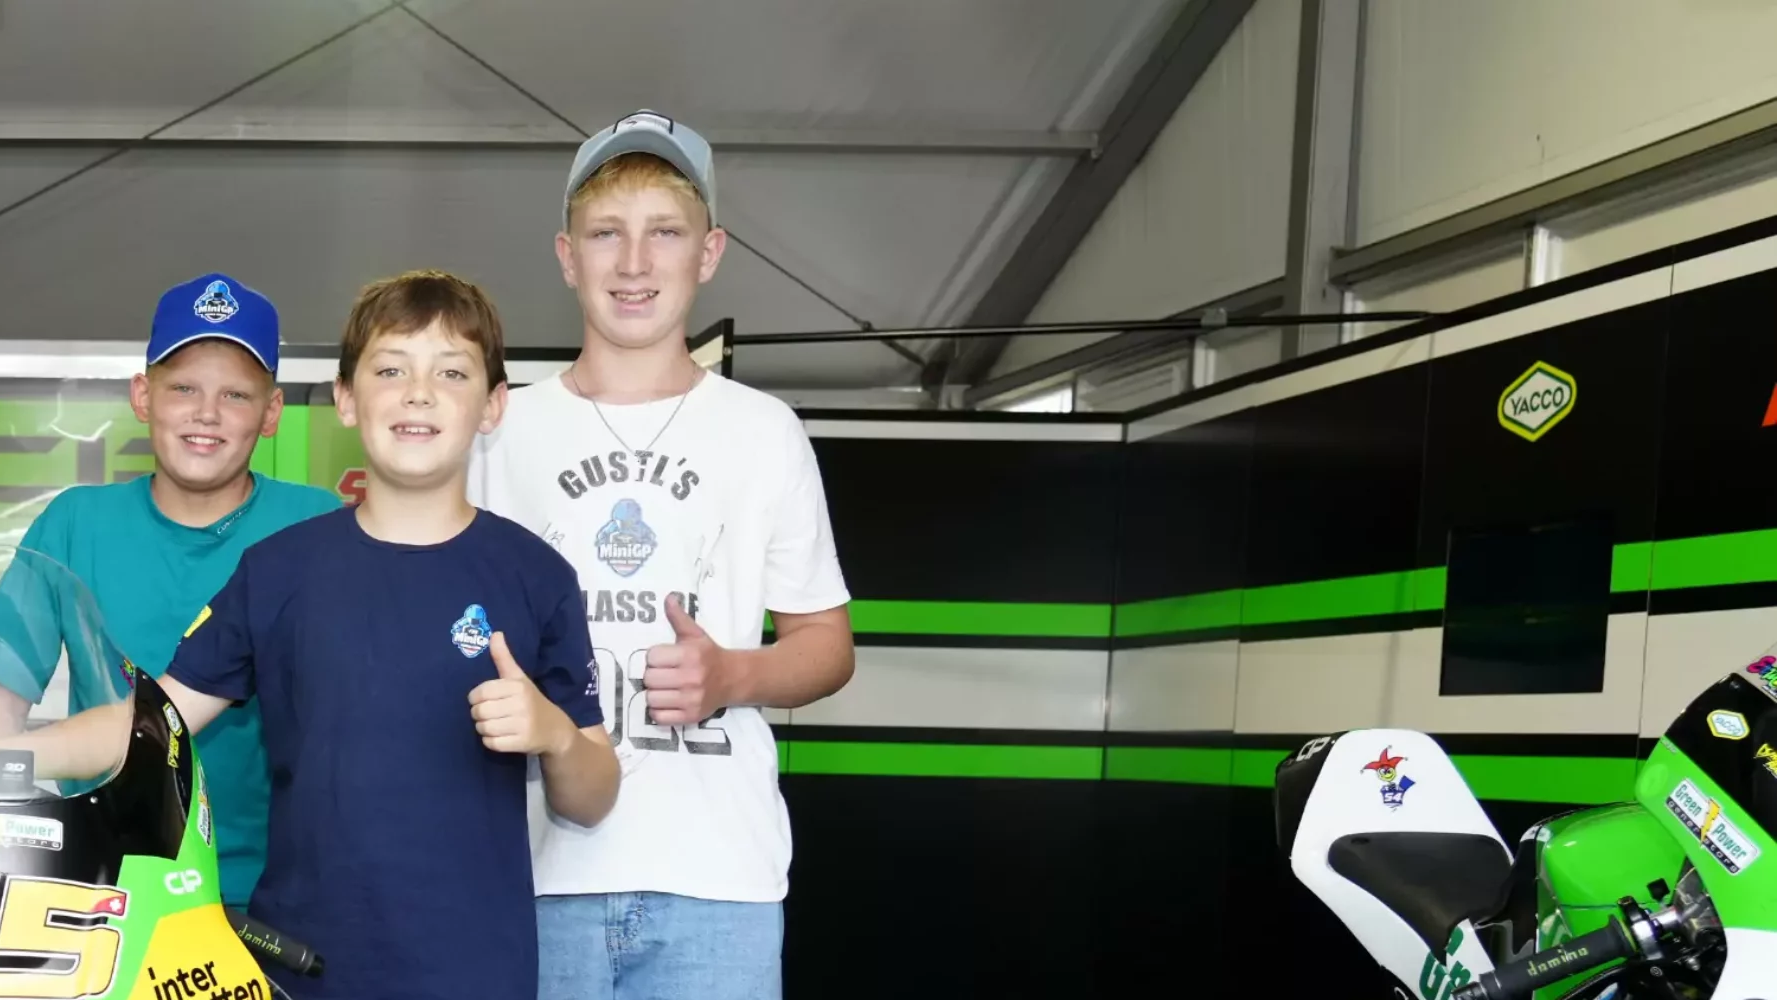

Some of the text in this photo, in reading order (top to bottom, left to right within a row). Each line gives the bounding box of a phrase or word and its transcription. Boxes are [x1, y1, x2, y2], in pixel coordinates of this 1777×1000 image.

[1509, 386, 1565, 416] YACCO
[599, 543, 653, 559] MiniGP
[1714, 716, 1741, 736] YACCO
[1384, 792, 1403, 803] 54
[5, 819, 56, 838] Power
[1674, 783, 1748, 861] Green Power
[1668, 800, 1739, 874] generators
[164, 868, 203, 894] CIP
[1527, 947, 1589, 976] domino
